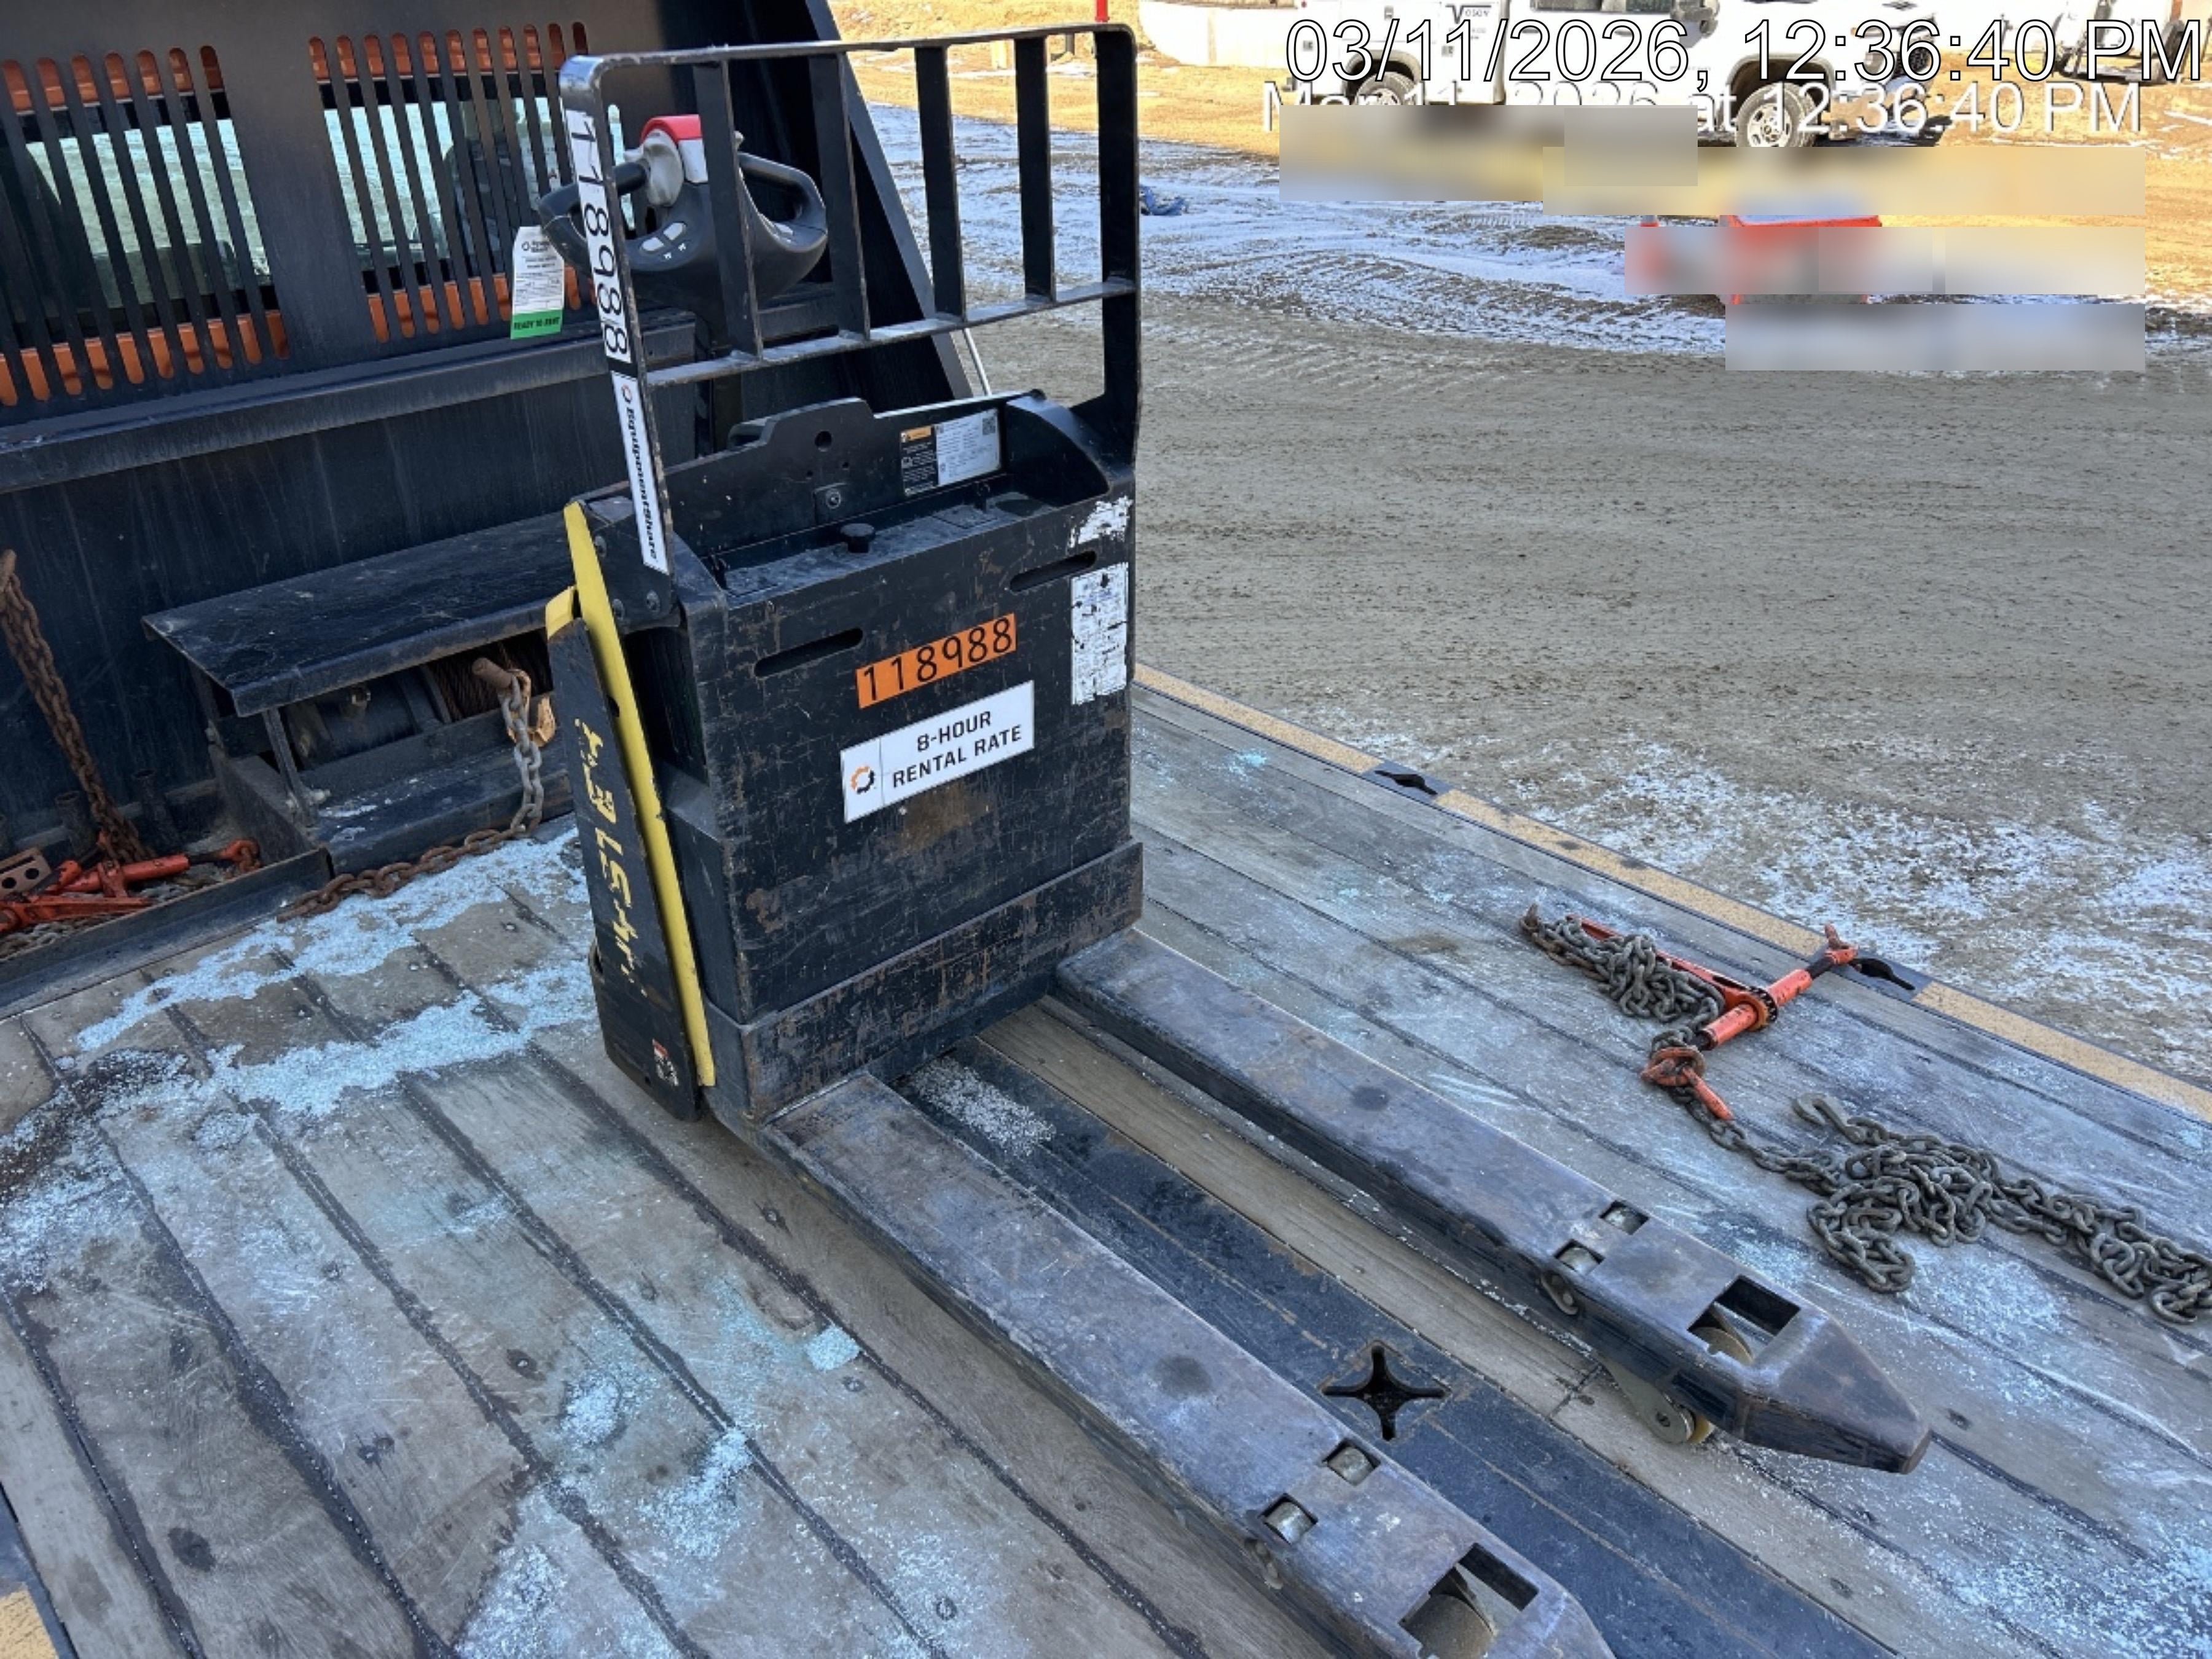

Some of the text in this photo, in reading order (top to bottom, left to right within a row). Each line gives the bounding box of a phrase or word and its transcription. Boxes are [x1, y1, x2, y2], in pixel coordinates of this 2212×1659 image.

[570, 120, 629, 355] 118988
[863, 616, 1013, 701] 118988
[892, 724, 1022, 788] RENTAL RATE
[917, 710, 992, 753] 8-HOUR
